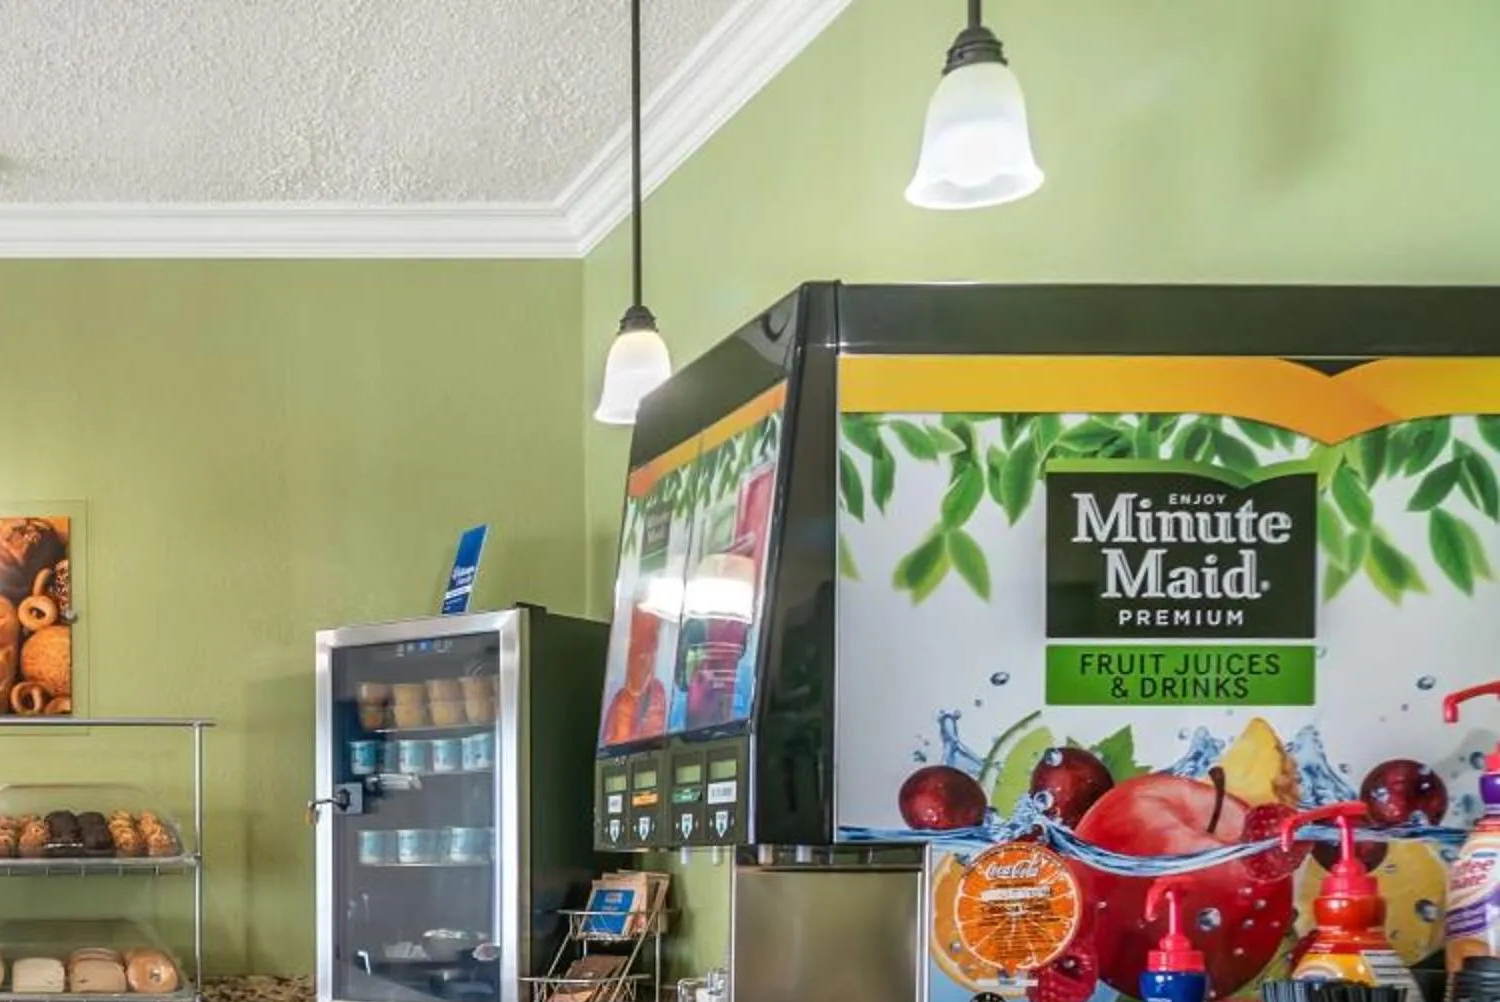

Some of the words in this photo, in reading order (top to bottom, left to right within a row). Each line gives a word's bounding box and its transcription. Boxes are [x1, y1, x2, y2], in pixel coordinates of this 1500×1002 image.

[1168, 493, 1228, 505] ENJOY
[1071, 492, 1293, 543] Minute
[1101, 548, 1262, 599] Maid
[1118, 609, 1244, 626] PREMIUM
[1080, 653, 1166, 676] FRUIT
[1174, 653, 1281, 677] JUICES
[1111, 677, 1129, 699] &
[1140, 677, 1249, 699] DRINKS
